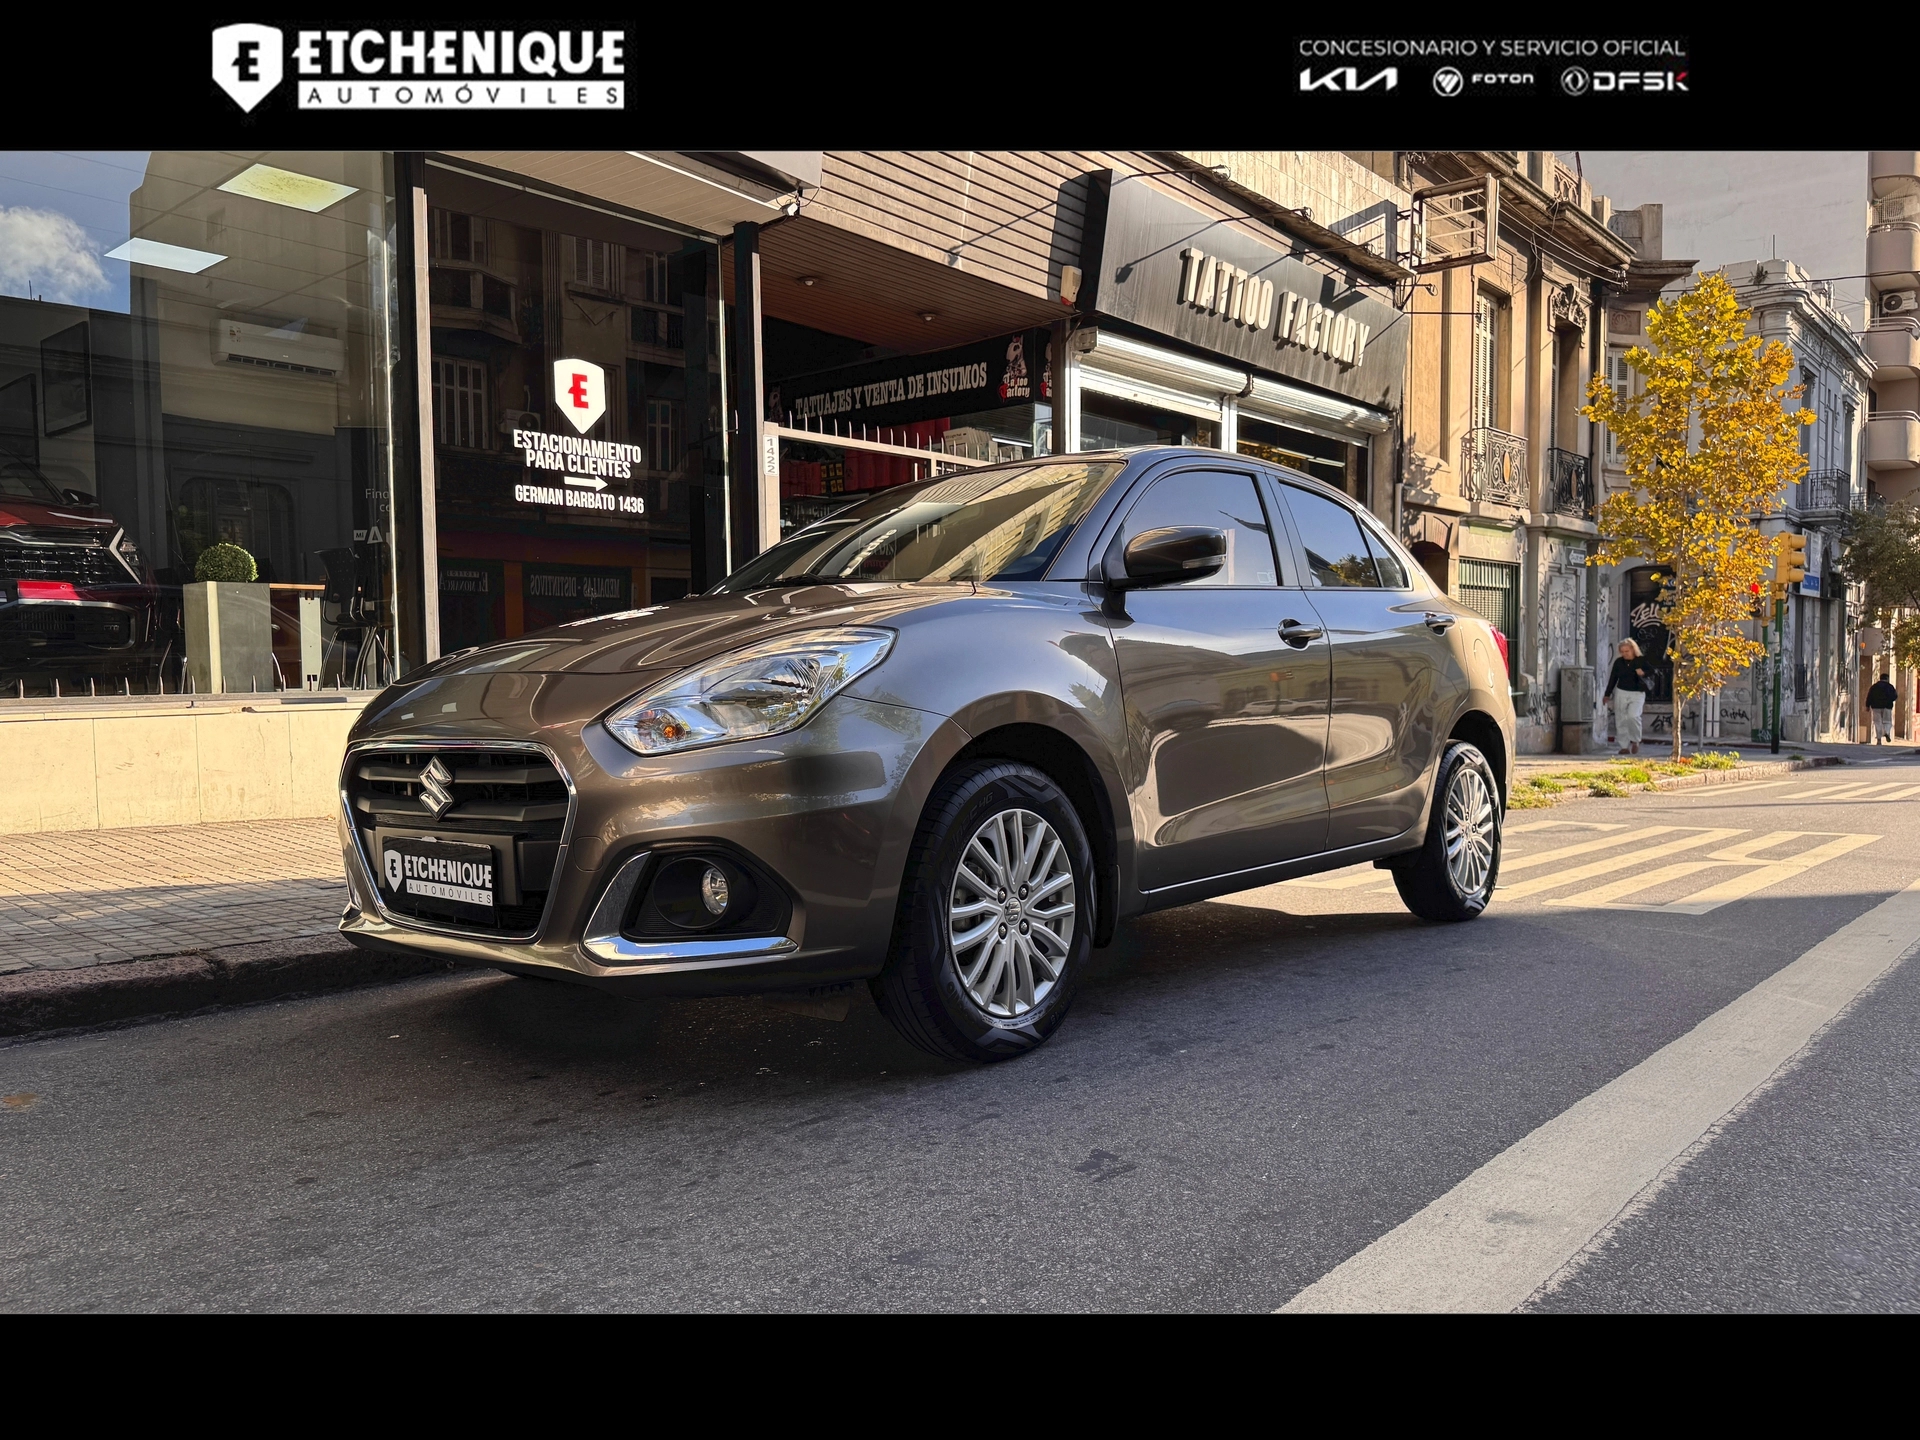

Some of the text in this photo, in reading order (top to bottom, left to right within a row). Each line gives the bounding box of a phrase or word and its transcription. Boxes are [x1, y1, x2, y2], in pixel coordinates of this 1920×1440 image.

[1183, 247, 1371, 368] TATTOO FACTORY
[795, 361, 988, 420] TATUAJES Y VENTA DE INSUMOS
[513, 429, 642, 464] ESTACIONAMIENTO
[525, 448, 631, 479] PARA CLIENTES
[766, 438, 776, 474] 1422
[515, 484, 645, 514] GERMAN BARBATO 1436
[404, 854, 493, 889] ETCHENIQUE
[408, 882, 492, 904] AUTOMÓVILES
